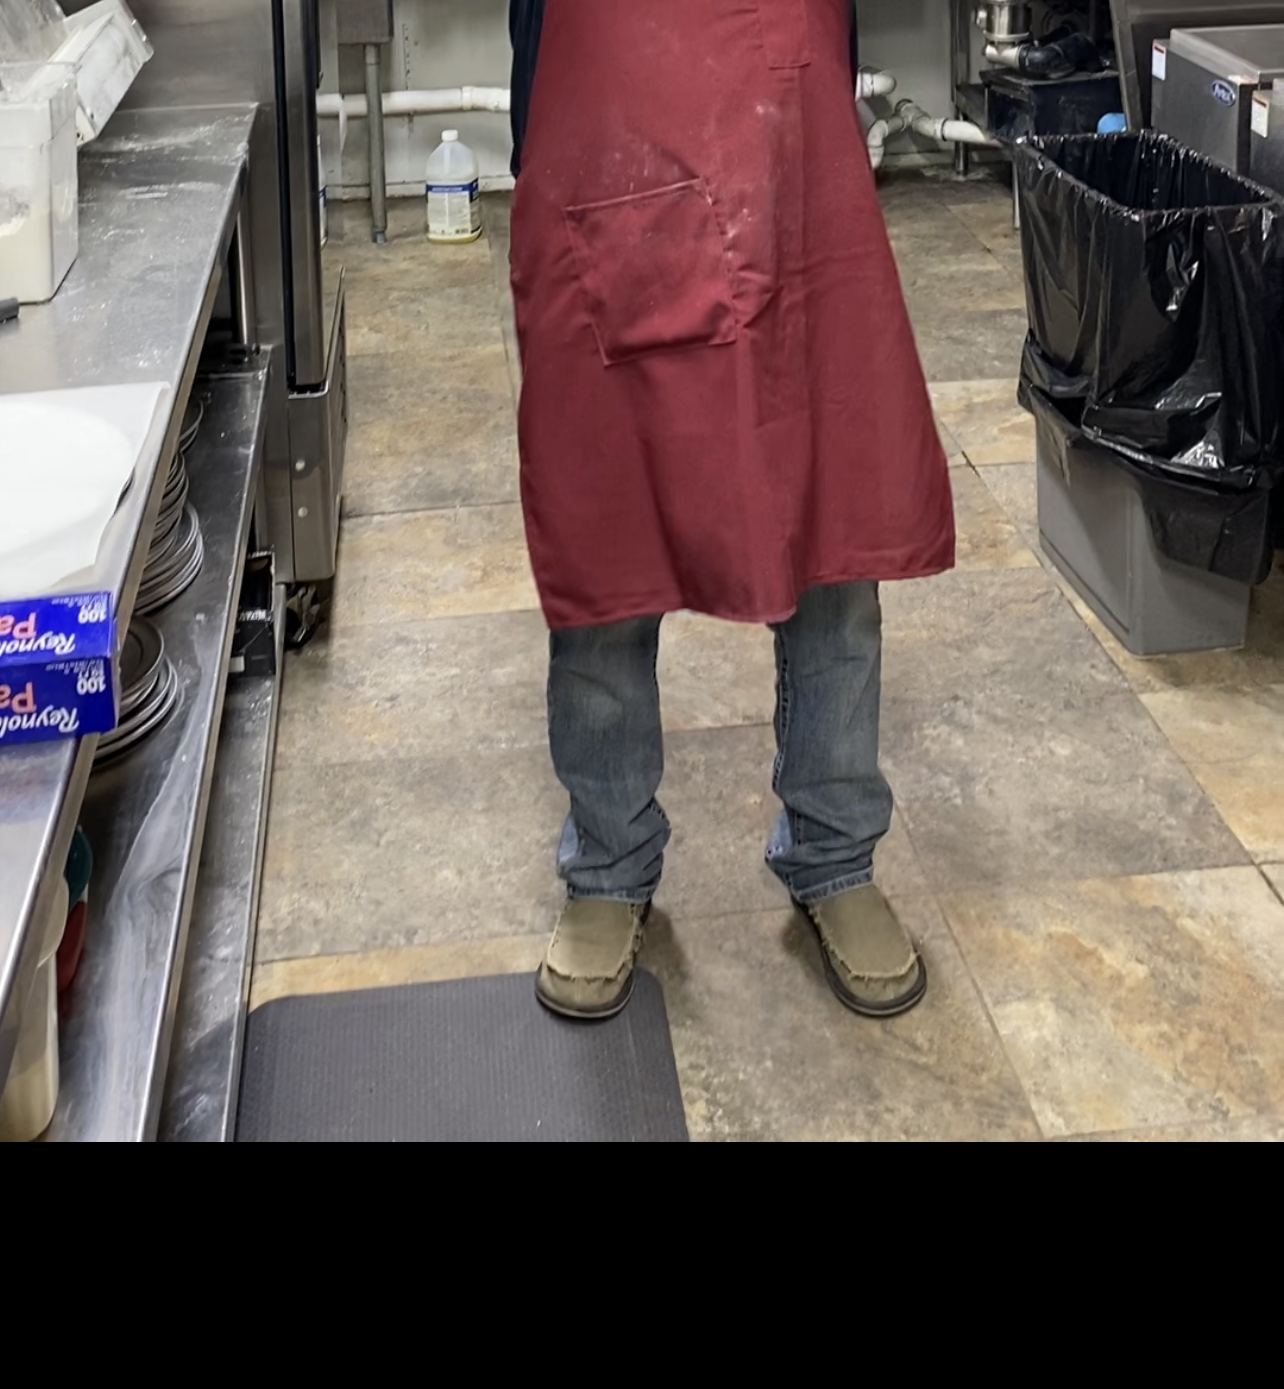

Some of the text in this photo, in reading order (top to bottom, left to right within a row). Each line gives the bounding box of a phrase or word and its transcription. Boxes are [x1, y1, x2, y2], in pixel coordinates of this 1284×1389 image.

[78, 606, 107, 624] 100
[0, 631, 76, 658] Reynol
[76, 677, 106, 696] 100
[0, 704, 80, 739] Reynol
